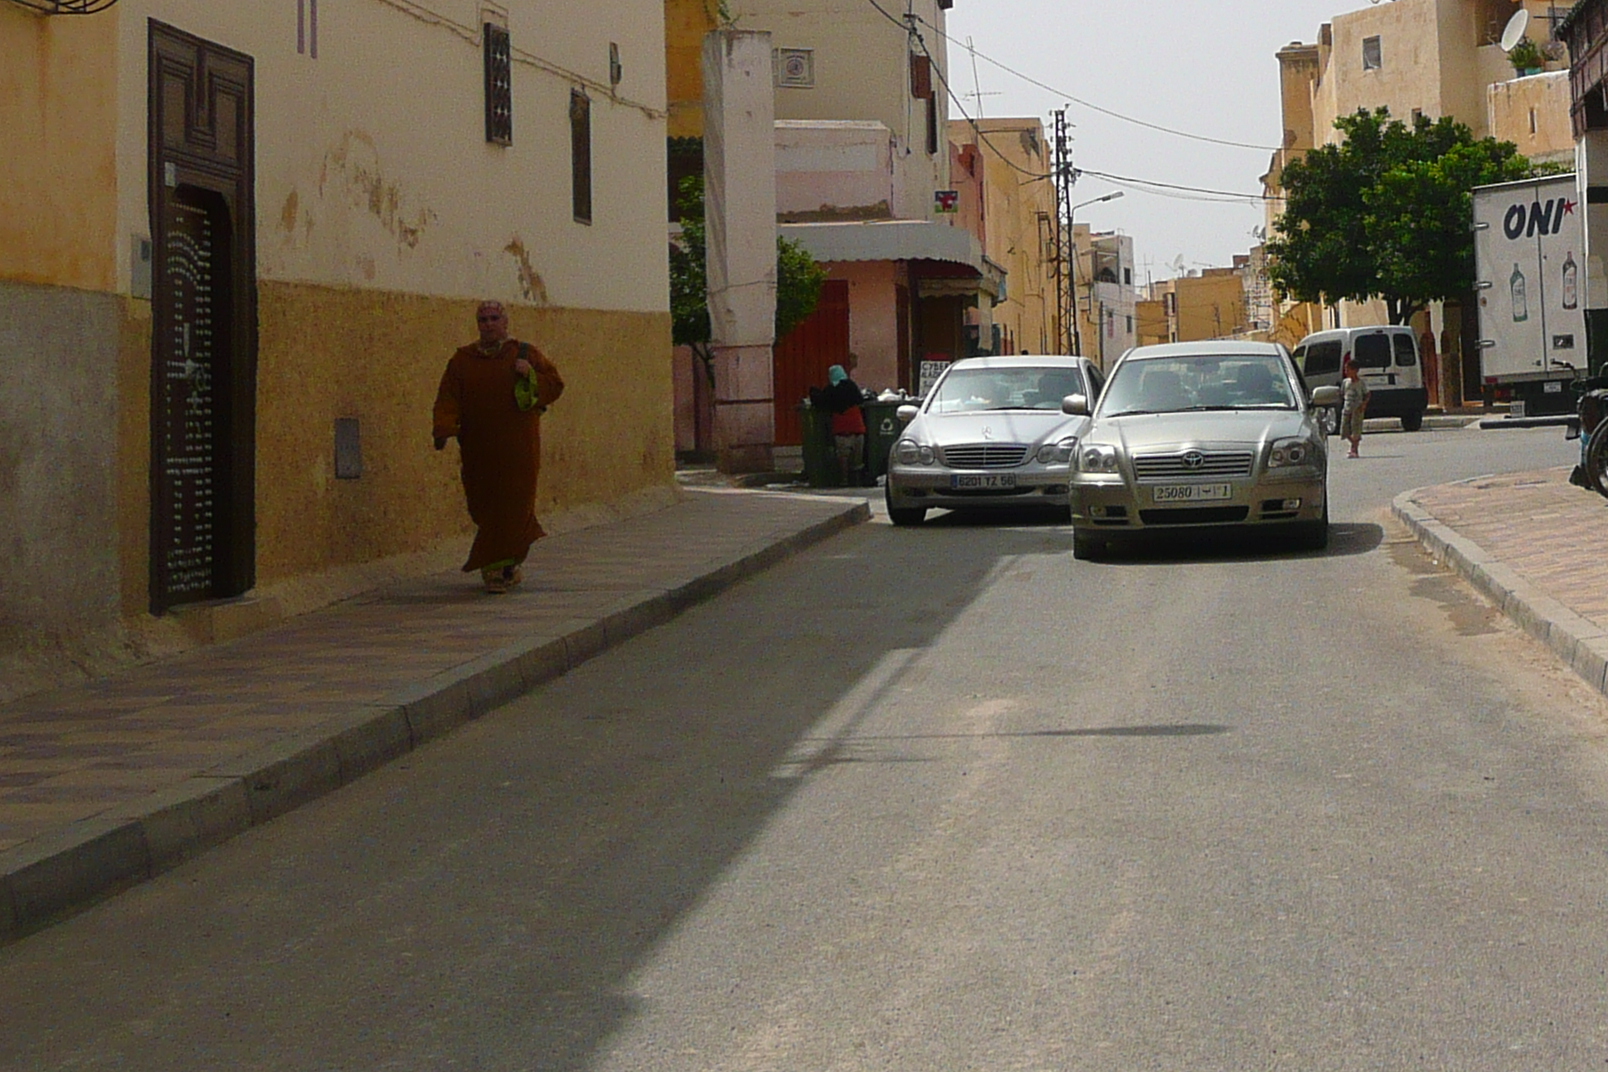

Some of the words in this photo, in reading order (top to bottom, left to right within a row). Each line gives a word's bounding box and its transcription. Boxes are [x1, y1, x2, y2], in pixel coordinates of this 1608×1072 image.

[1503, 197, 1566, 240] ONI
[958, 476, 982, 486] 6201
[1156, 486, 1192, 499] 25080
[1222, 485, 1228, 497] 1
